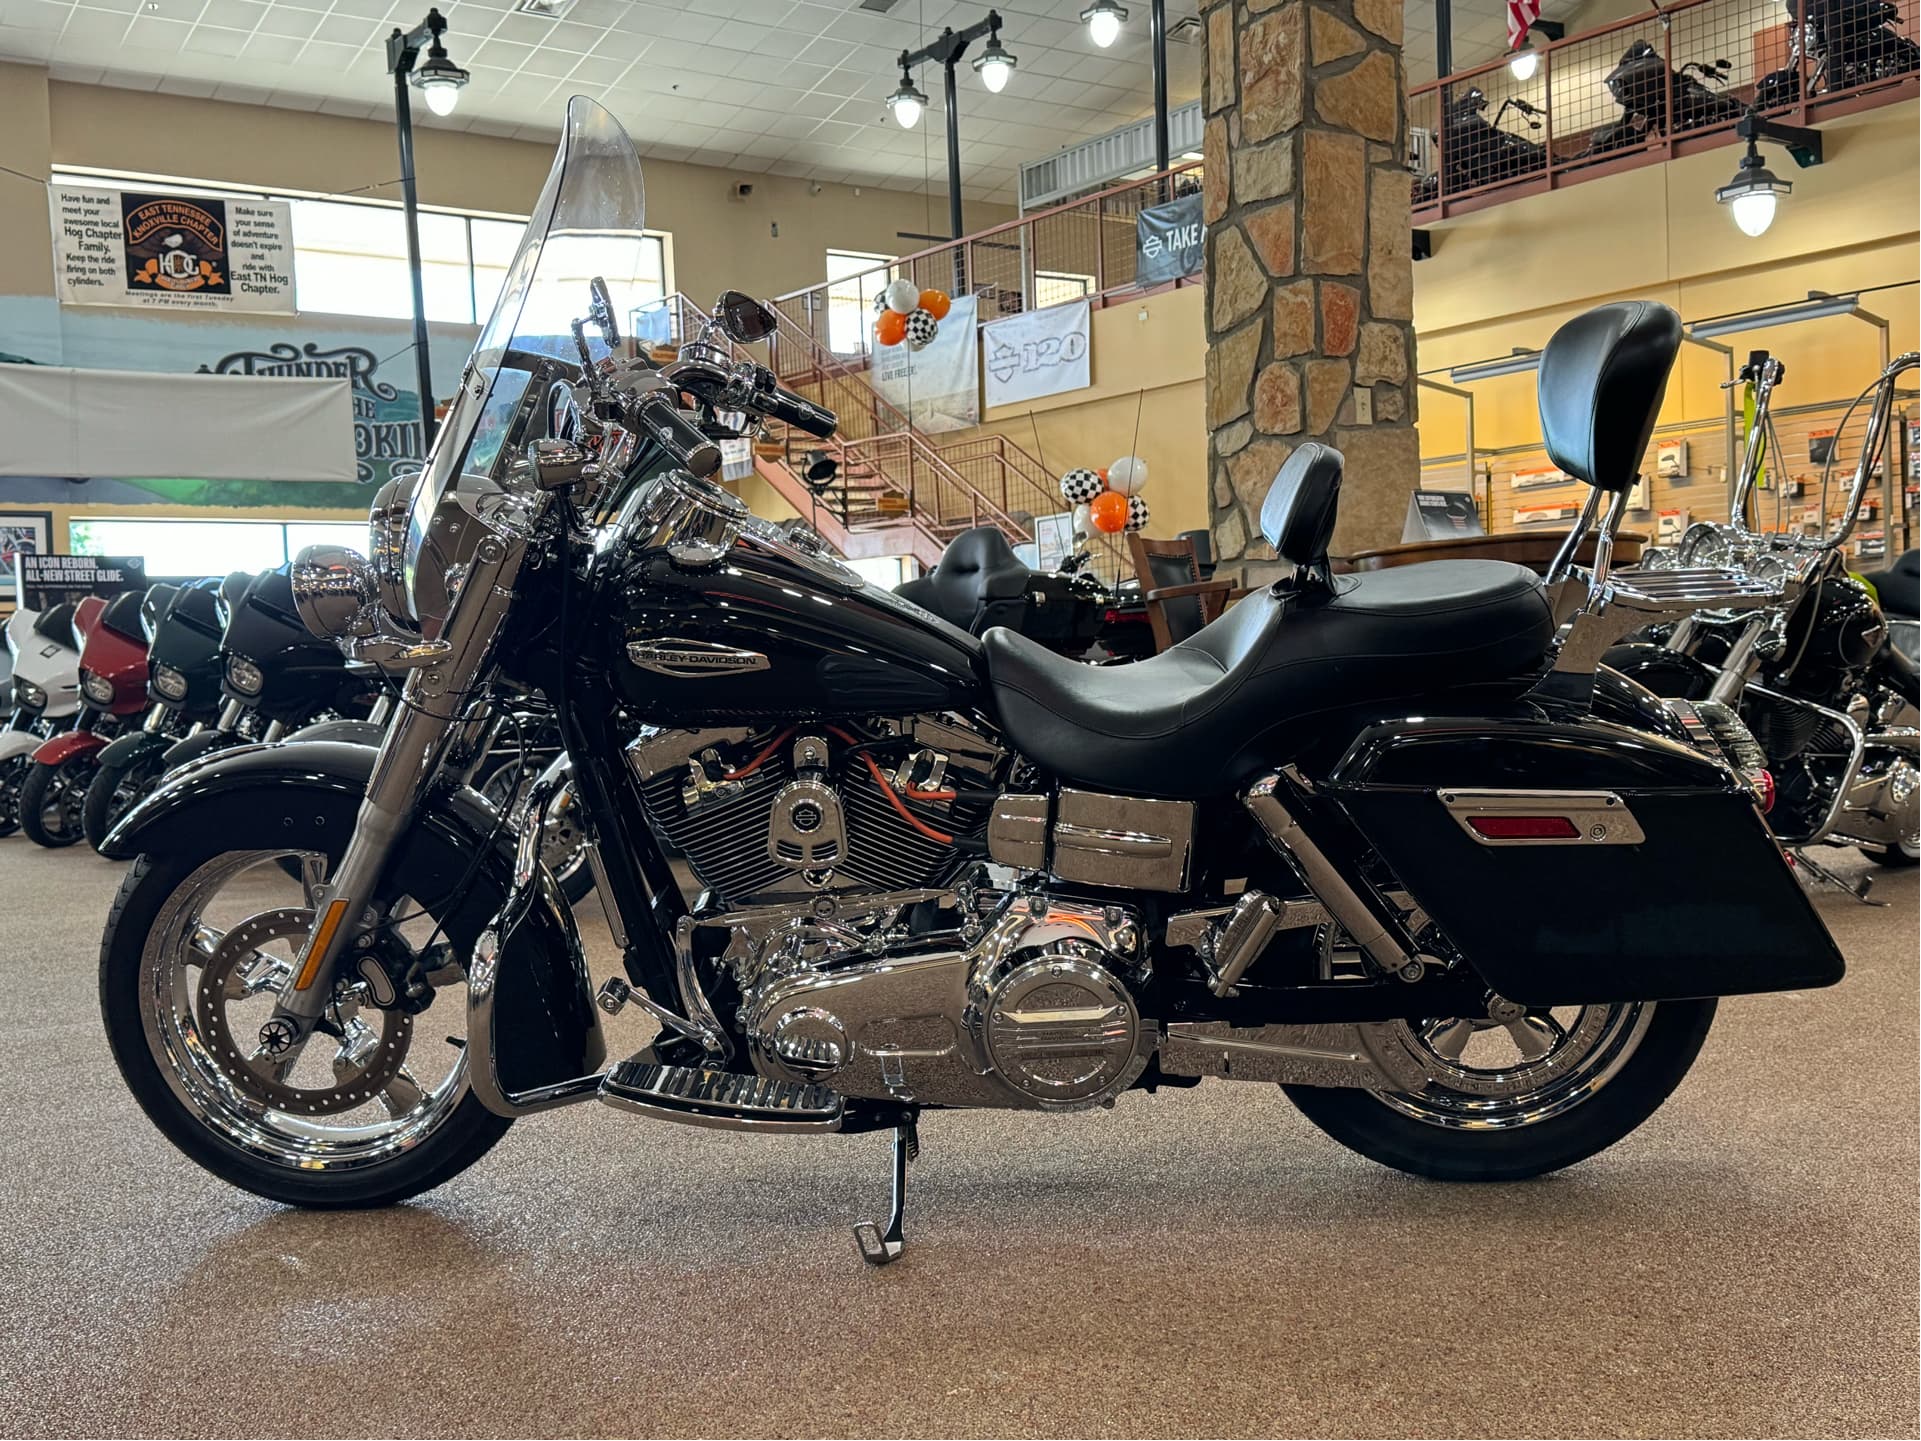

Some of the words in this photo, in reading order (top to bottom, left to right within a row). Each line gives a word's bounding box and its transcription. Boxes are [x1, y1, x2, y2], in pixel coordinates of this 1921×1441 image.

[61, 193, 80, 203] Have
[82, 195, 94, 204] fun
[96, 196, 110, 205] and
[62, 206, 81, 214] meet
[83, 208, 100, 216] your
[138, 206, 160, 220] EAST
[162, 204, 212, 226] TENNESSEE
[234, 206, 255, 216] Make
[64, 218, 100, 226] awesome
[101, 220, 120, 228] local
[234, 220, 251, 228] your
[64, 226, 83, 239] Hog
[85, 228, 122, 240] Chapter
[133, 215, 180, 238] KNOXVILLE
[180, 216, 219, 245] CHAPTER
[232, 228, 241, 236] of
[242, 230, 279, 240] adventure
[1166, 223, 1199, 252] TAKE
[78, 241, 111, 254] Family.
[231, 240, 258, 249] doesn't
[260, 242, 282, 252] expire
[66, 253, 86, 264] Keep
[87, 254, 100, 263] the
[101, 256, 116, 264] ride
[250, 253, 265, 261] and
[66, 265, 86, 276] firing
[99, 266, 116, 276] both
[242, 263, 256, 271] ride
[258, 264, 275, 272] with
[67, 278, 104, 287] cylinders.
[230, 270, 252, 282] East
[253, 272, 268, 283] TN
[270, 273, 289, 286] Hog
[240, 283, 280, 296] Chapter.
[1022, 330, 1087, 373] 120
[354, 398, 376, 419] HE
[25, 556, 38, 569] AN
[39, 557, 60, 569] ICON
[62, 558, 99, 570] REBORN.
[26, 569, 64, 582] ALL-NEW
[65, 570, 96, 582] STREET
[96, 570, 124, 582] GLIDE.
